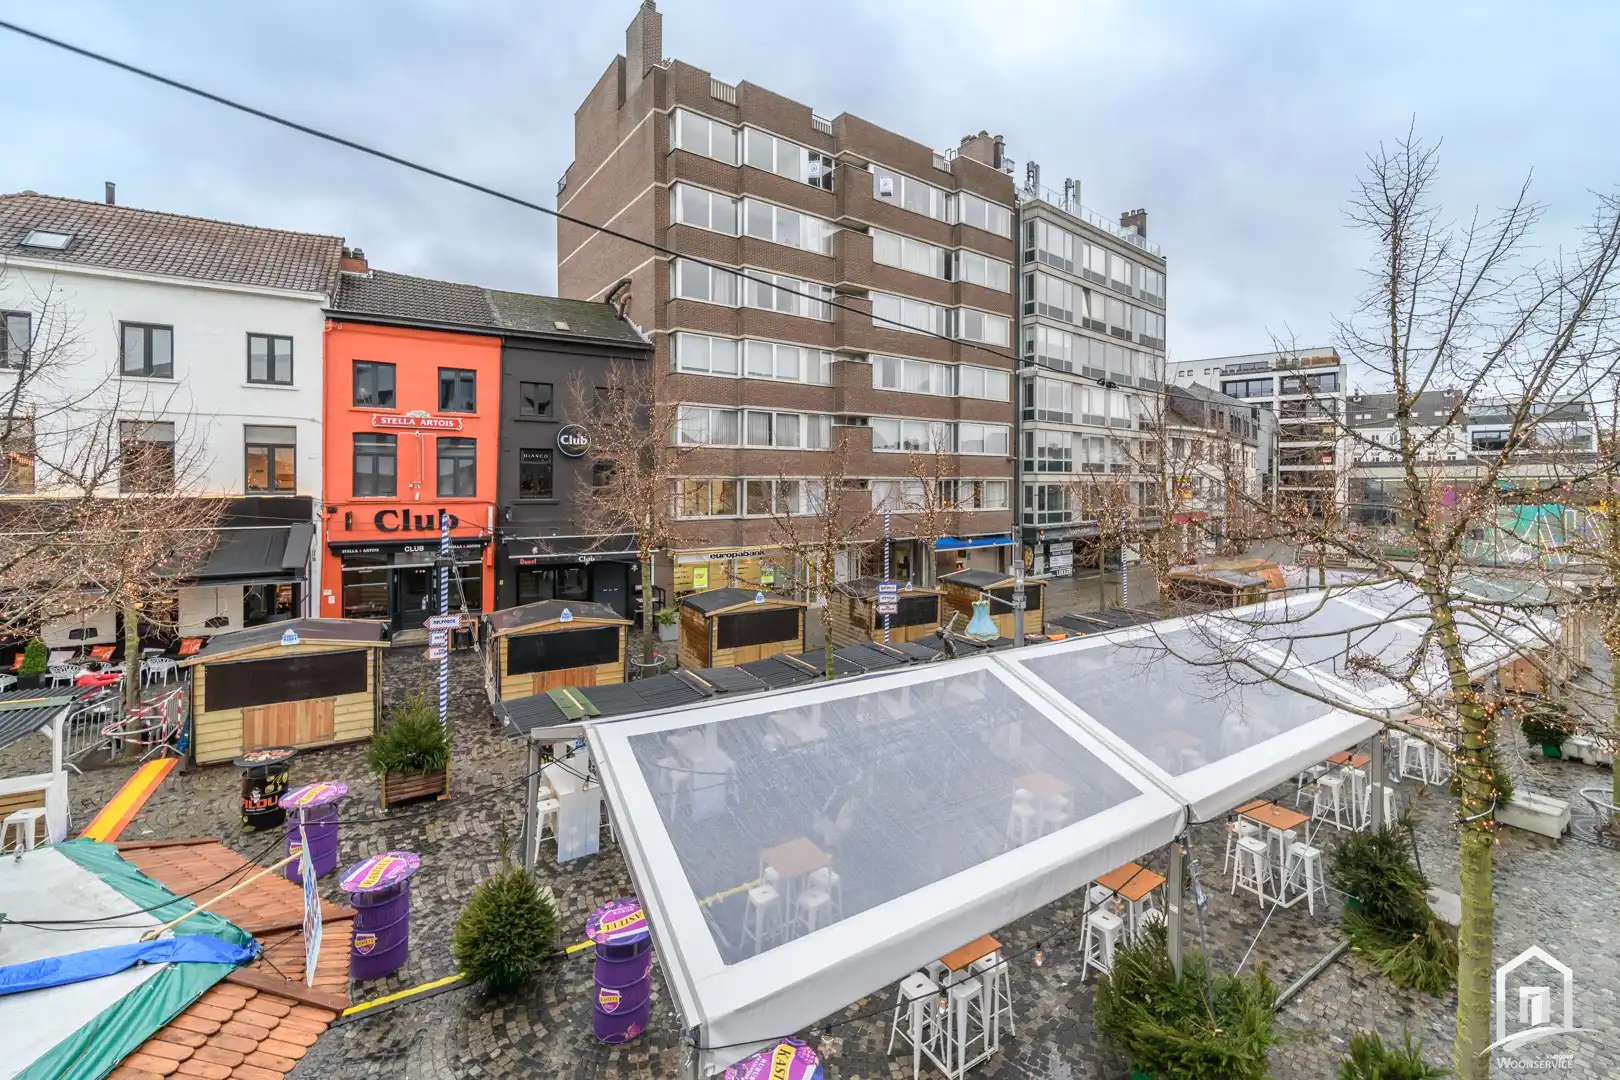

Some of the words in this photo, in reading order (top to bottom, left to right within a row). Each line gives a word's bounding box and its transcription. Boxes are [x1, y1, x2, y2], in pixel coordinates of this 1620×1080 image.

[381, 417, 415, 425] STELLA
[420, 419, 454, 427] ARTOIS
[560, 434, 588, 445] Club
[374, 509, 459, 533] Club
[709, 550, 765, 560] europabank
